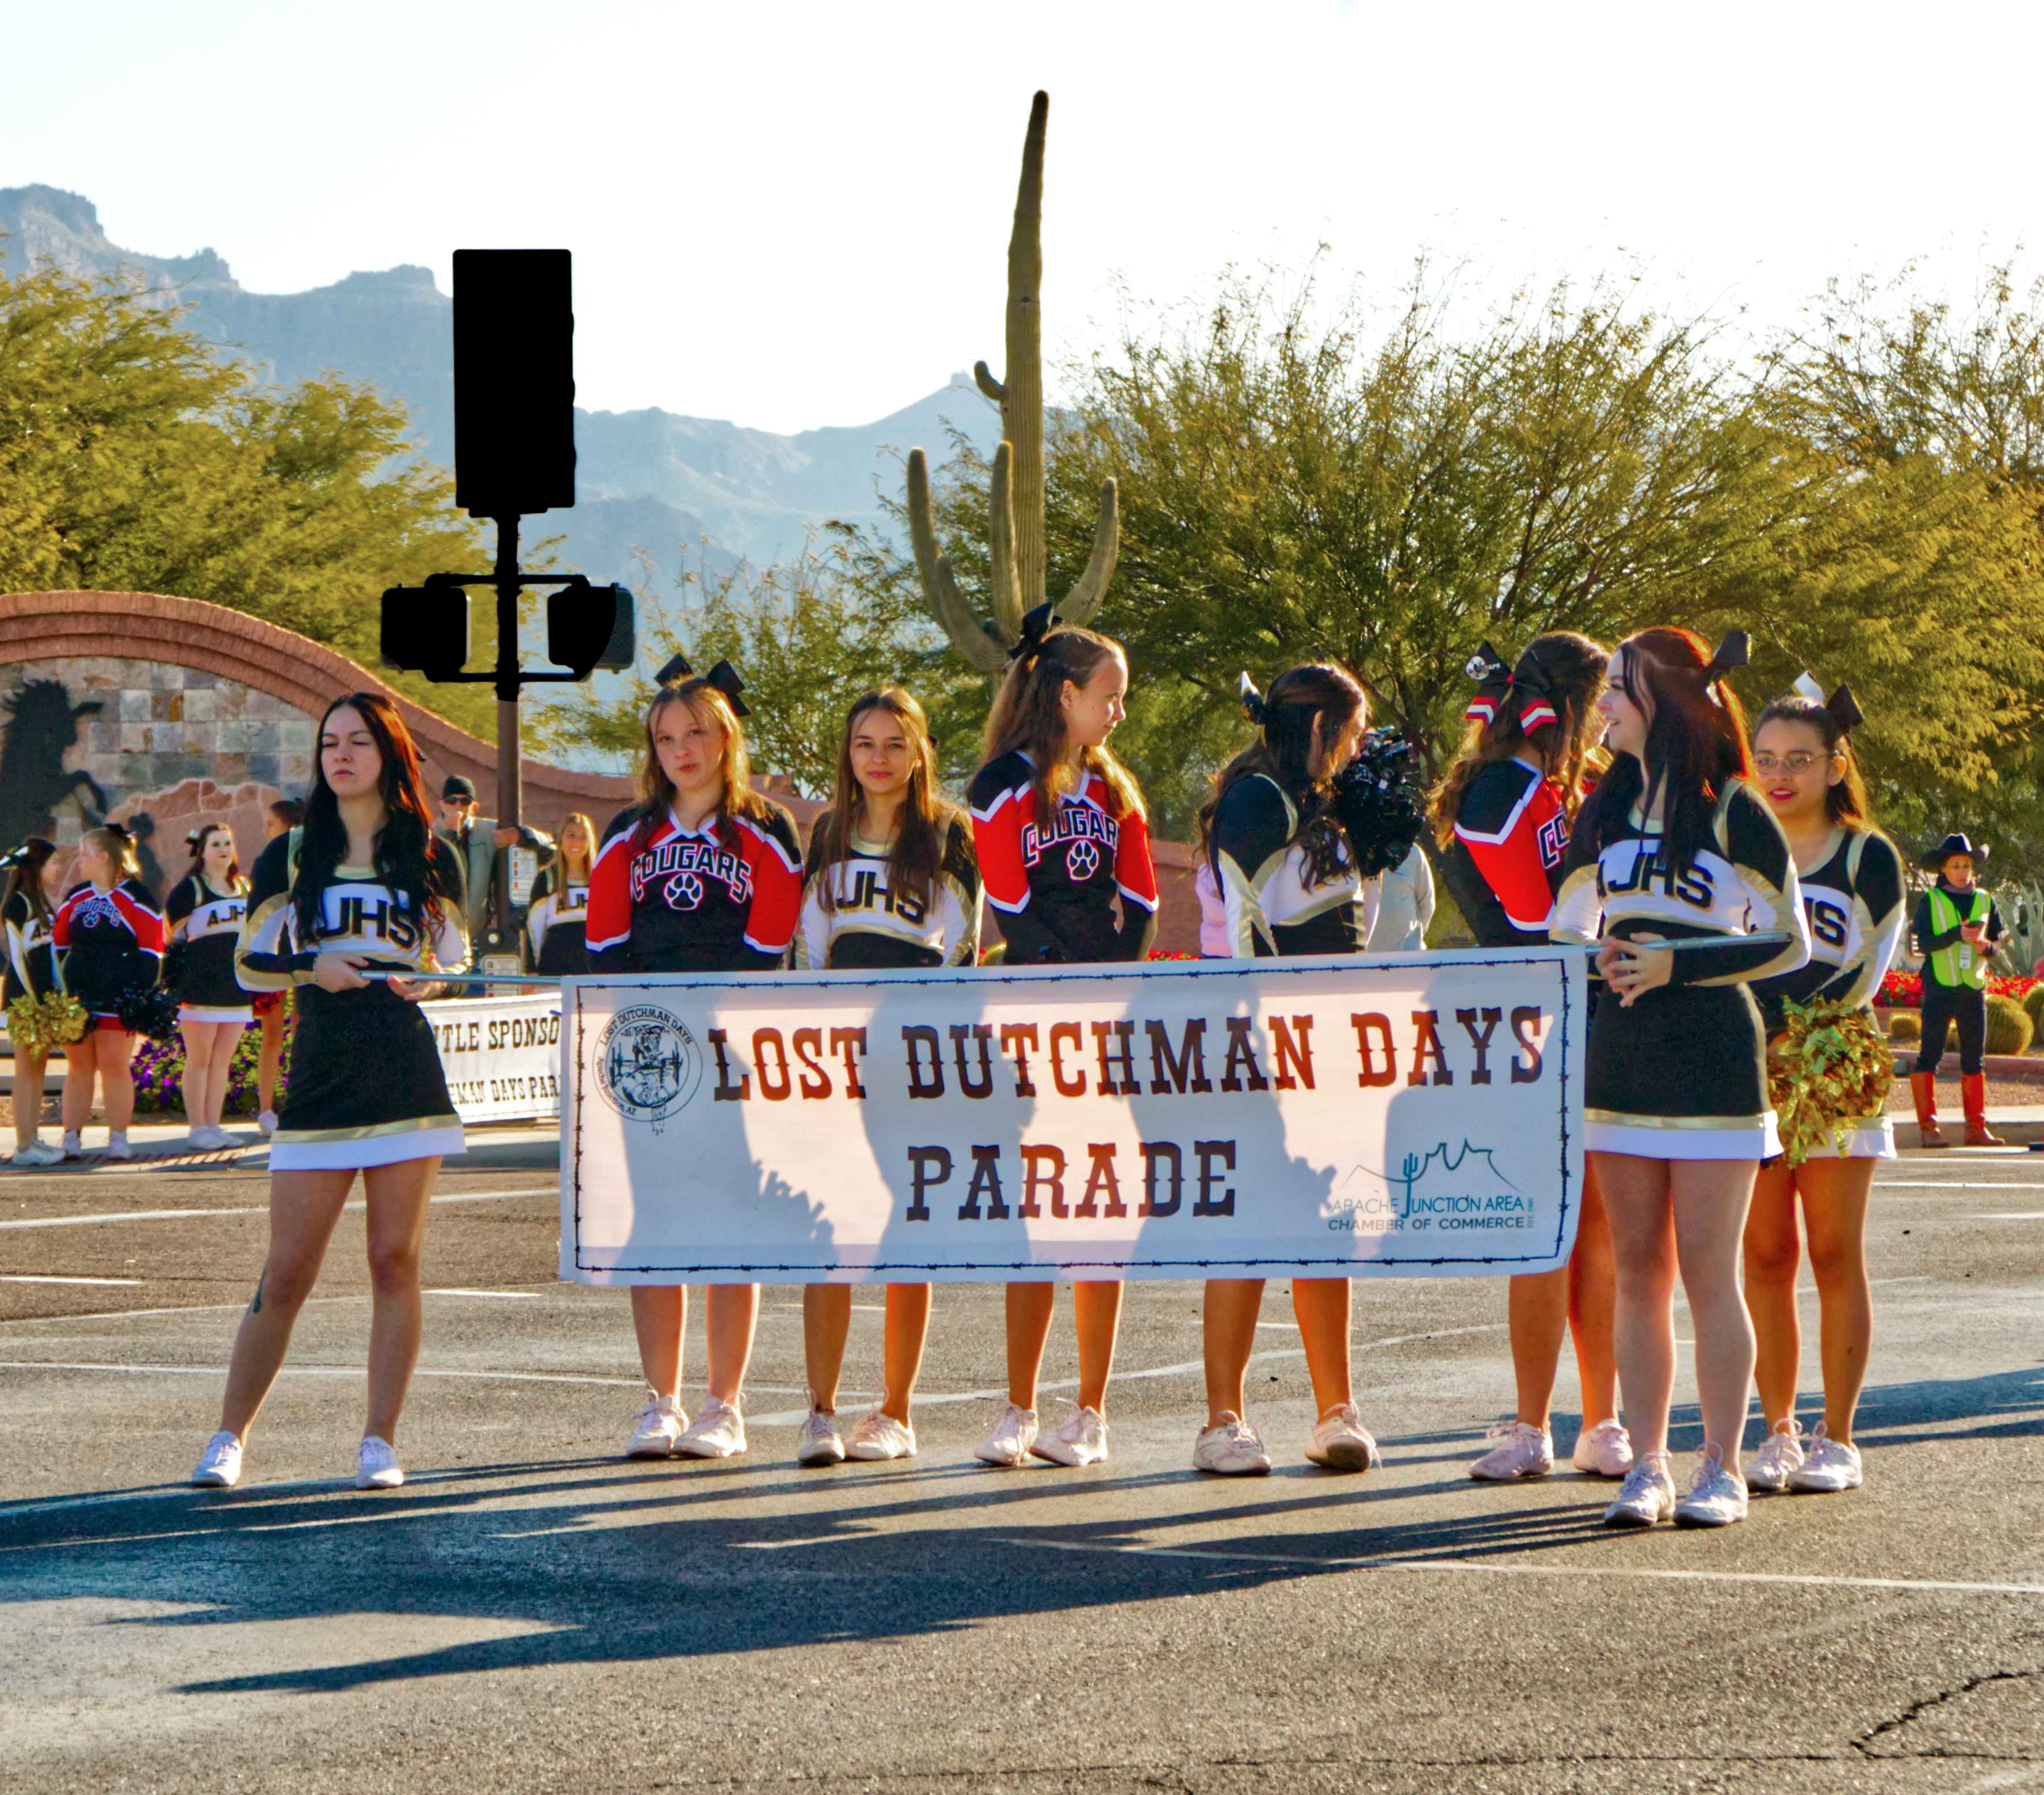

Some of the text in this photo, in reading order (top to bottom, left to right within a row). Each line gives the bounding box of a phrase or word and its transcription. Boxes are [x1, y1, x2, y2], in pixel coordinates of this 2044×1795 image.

[1021, 808, 1120, 868] COUGAR
[631, 844, 751, 904] COUGARS
[1597, 851, 1714, 911] JHS
[316, 897, 415, 949] JHS
[600, 1008, 693, 1046] LOST DUTCHMAN DAYS
[708, 1005, 1543, 1102] LOST DUTCHMAN DAYS
[490, 1077, 526, 1102] DAYS
[529, 1075, 561, 1099] PAR
[626, 1106, 637, 1116] AZ
[906, 1140, 1236, 1221] PARADE
[1331, 1198, 1398, 1213] APACHE
[1400, 1190, 1481, 1219] JUNCTION
[1484, 1196, 1525, 1212] AREA
[1328, 1216, 1525, 1231] CHAMBER OF COMMERCE
